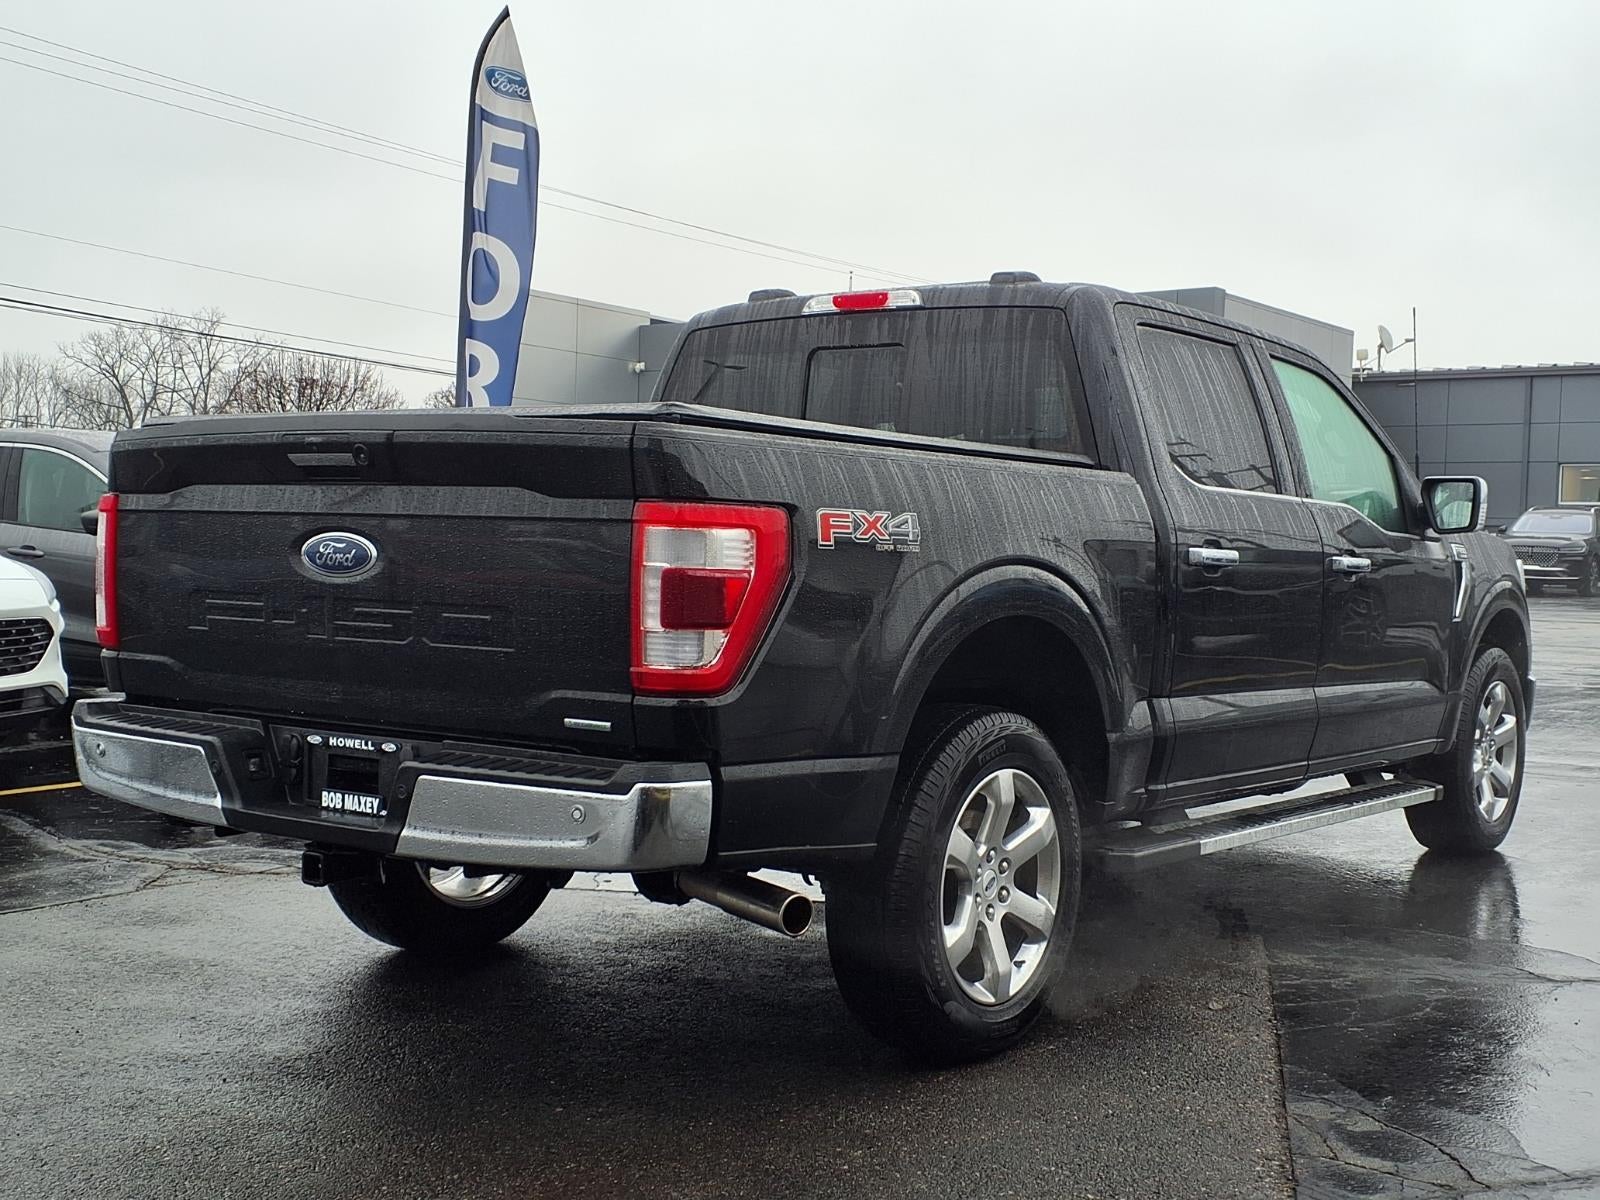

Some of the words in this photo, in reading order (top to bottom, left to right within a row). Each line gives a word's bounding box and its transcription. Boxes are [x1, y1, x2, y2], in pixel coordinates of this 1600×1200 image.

[491, 70, 528, 97] Ford
[816, 507, 921, 549] FX4
[316, 541, 357, 566] Ford
[329, 737, 375, 750] HOWELL
[321, 791, 343, 809] BOB
[344, 794, 380, 814] MAXEY
